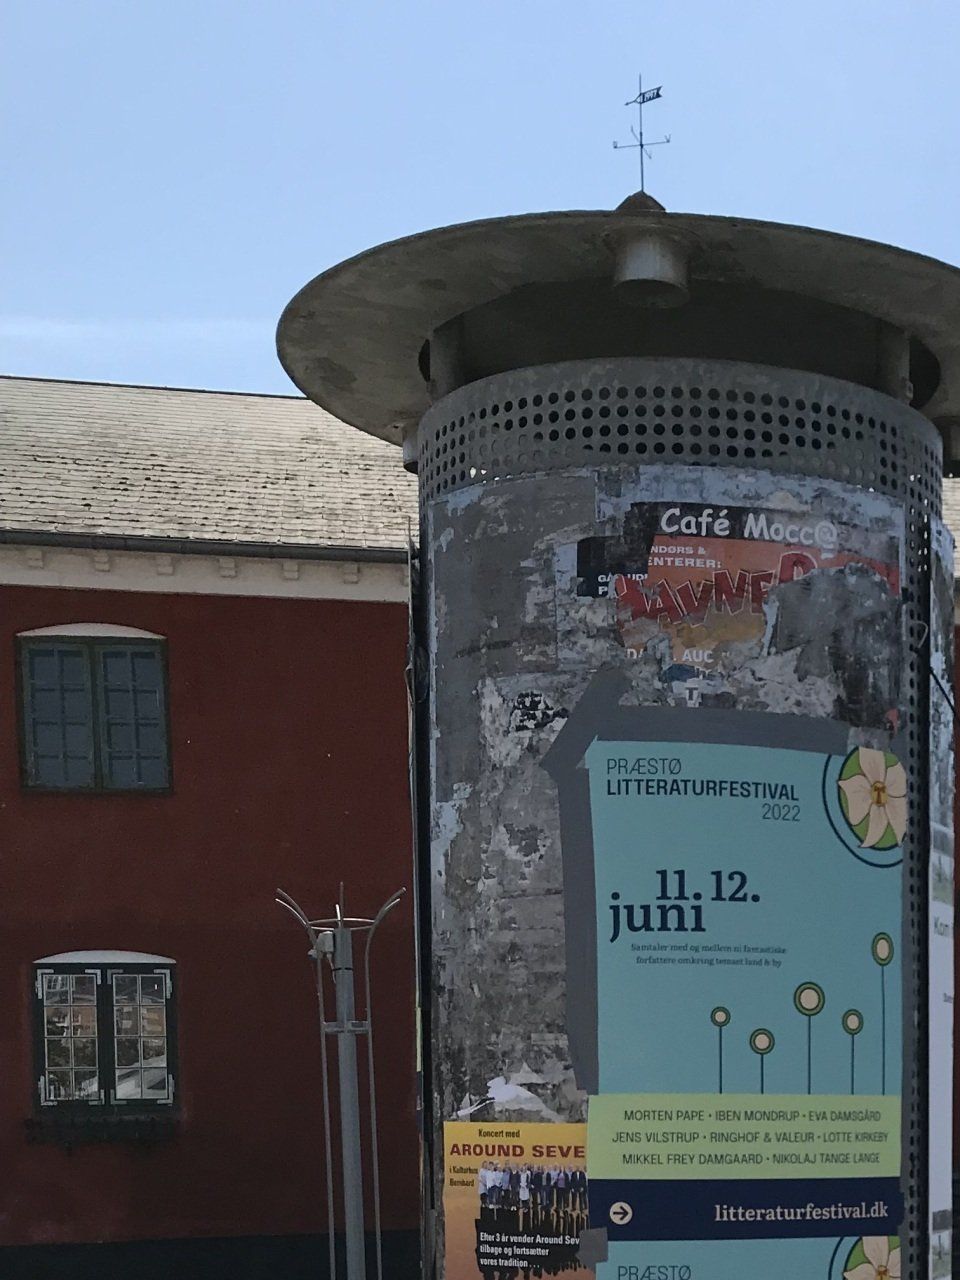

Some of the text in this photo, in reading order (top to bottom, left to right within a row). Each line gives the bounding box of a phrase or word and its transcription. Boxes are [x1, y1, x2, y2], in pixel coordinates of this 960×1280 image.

[661, 507, 730, 537] Café
[607, 757, 682, 775] PRÆSTØ
[607, 779, 800, 802] LITTERATURFESTIVAL
[762, 803, 801, 823] 2022
[711, 870, 761, 903] 12.
[610, 892, 707, 943] juni
[624, 1108, 881, 1122] MORTEN PAPE IBEN MONDRUP EVA DAMSGÅRD
[478, 1129, 520, 1138] Koncert med
[612, 1131, 889, 1143] JENS VILSTRUP RINGHOF & VALEUR LOTTE KIRKEBY
[450, 1143, 585, 1158] AROUND SEVE
[622, 1152, 881, 1165] MIKKEL FREY DAMGAARD NIKOLAJ TANGE LANGE
[715, 1201, 888, 1222] litteraturfestival.dk
[480, 1232, 494, 1242] Efter
[496, 1233, 501, 1242] 3
[510, 1234, 534, 1243] vender
[535, 1235, 563, 1244] Around
[565, 1236, 580, 1245] Sev
[480, 1245, 549, 1256] tilbage og fortsætter
[480, 1258, 498, 1266] vores
[499, 1258, 528, 1267] tradition
[618, 1265, 691, 1280] PRÆSTØ
